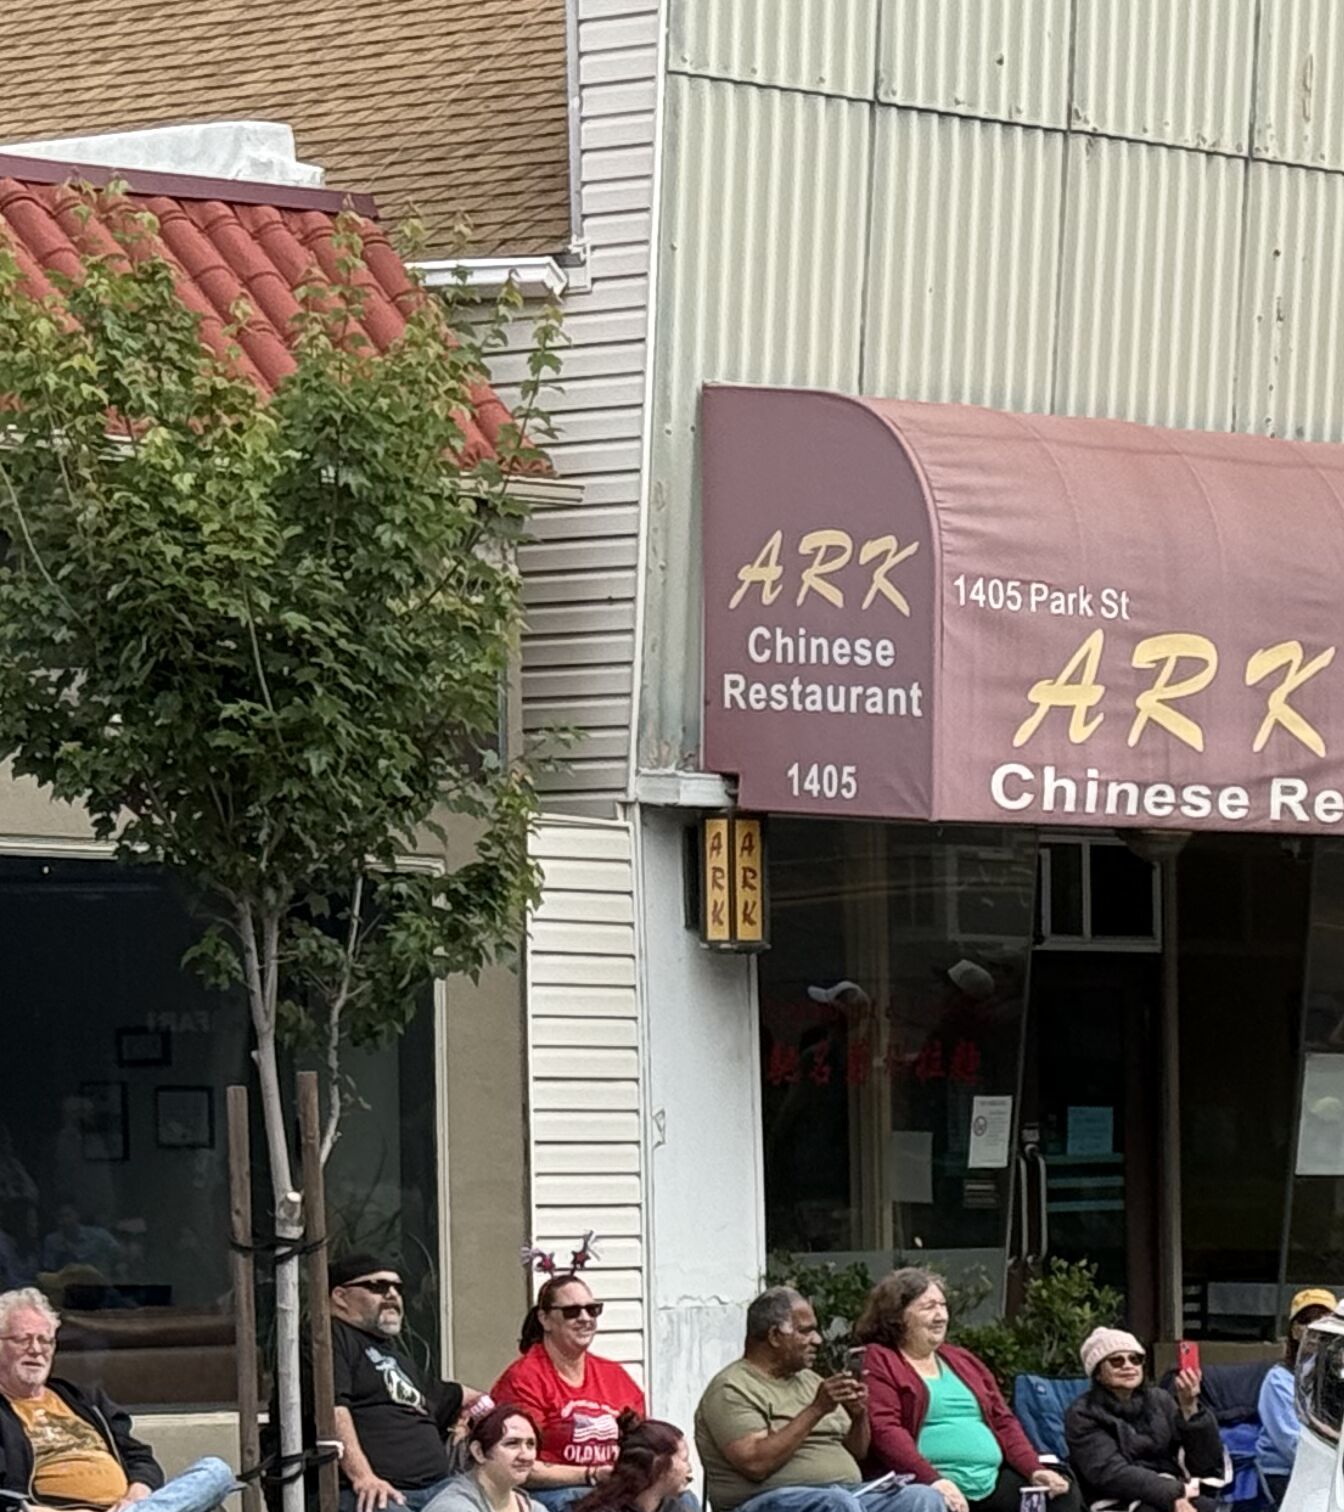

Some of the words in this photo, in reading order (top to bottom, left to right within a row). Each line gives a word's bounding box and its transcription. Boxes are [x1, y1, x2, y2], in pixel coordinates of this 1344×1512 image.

[730, 530, 919, 618] ARK
[953, 575, 1023, 613] 1405
[1030, 581, 1094, 618] Park
[1101, 587, 1131, 621] St
[747, 626, 896, 669] Chinese
[723, 674, 924, 718] Restaurant
[1012, 628, 1337, 758] ARK
[787, 763, 858, 800] 1405
[990, 762, 1250, 822] Chinese
[709, 831, 726, 927] ARK
[740, 831, 758, 927] ARK
